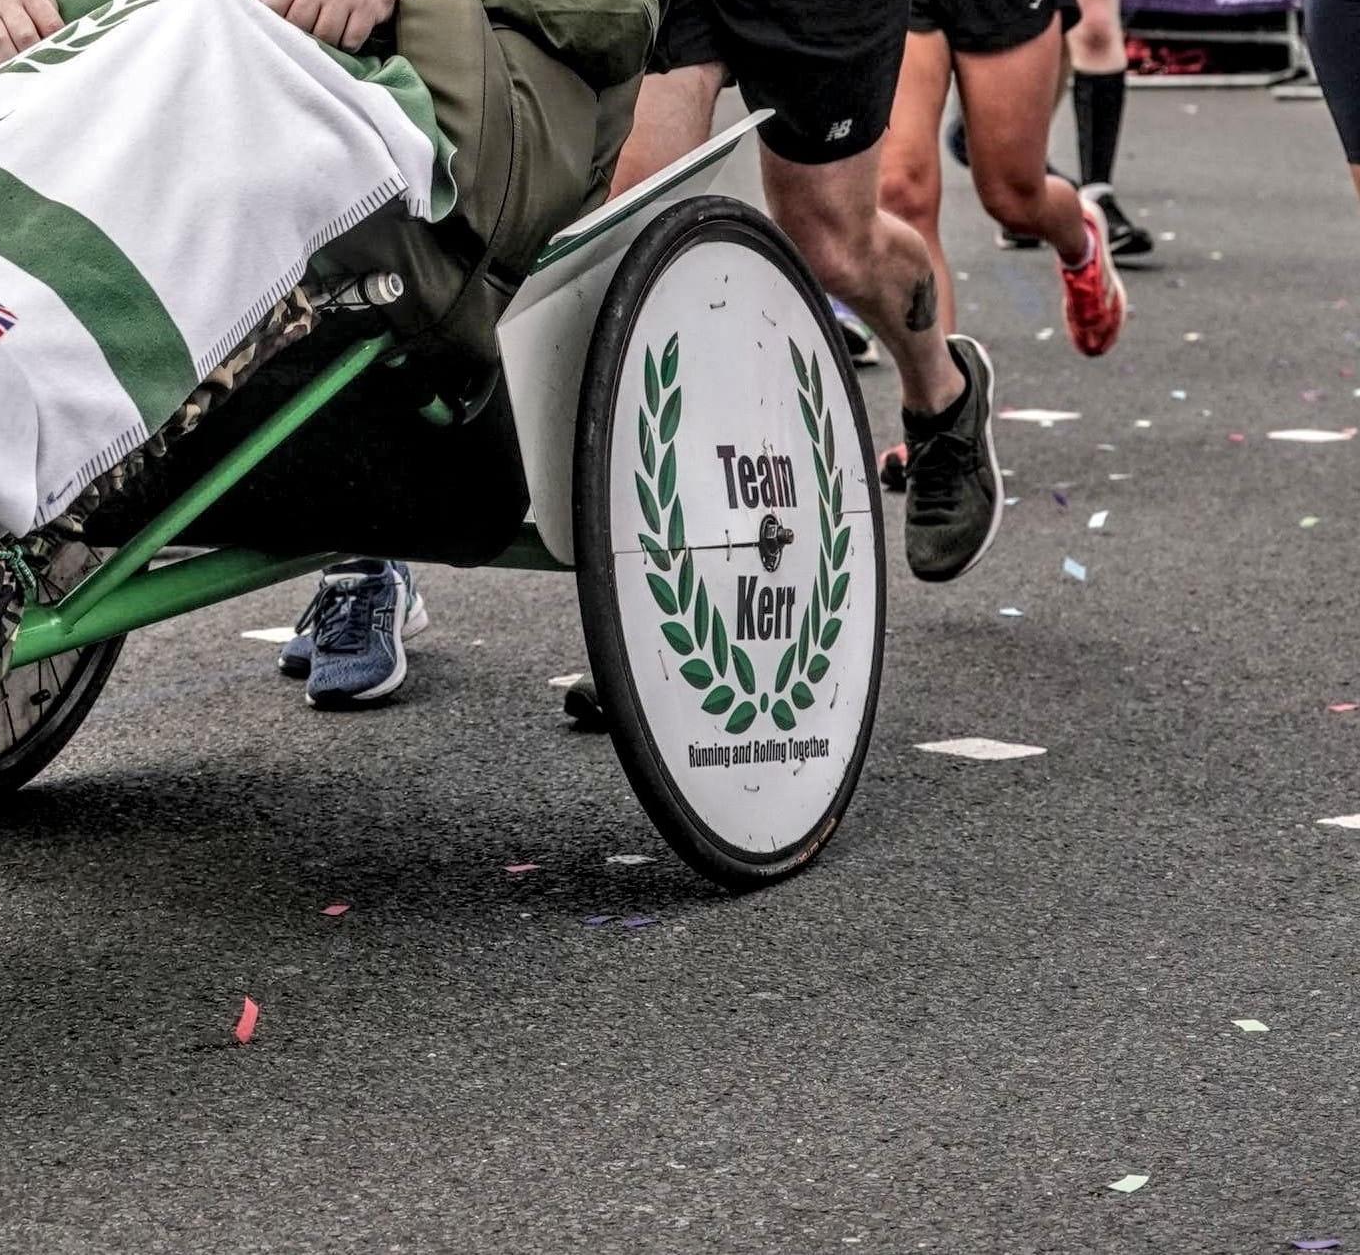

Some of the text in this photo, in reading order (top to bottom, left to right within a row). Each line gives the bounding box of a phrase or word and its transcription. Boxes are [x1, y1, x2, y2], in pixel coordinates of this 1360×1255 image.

[716, 445, 798, 509] Team
[736, 575, 796, 641] Kerr
[688, 735, 829, 768] Running and Rolling Together
